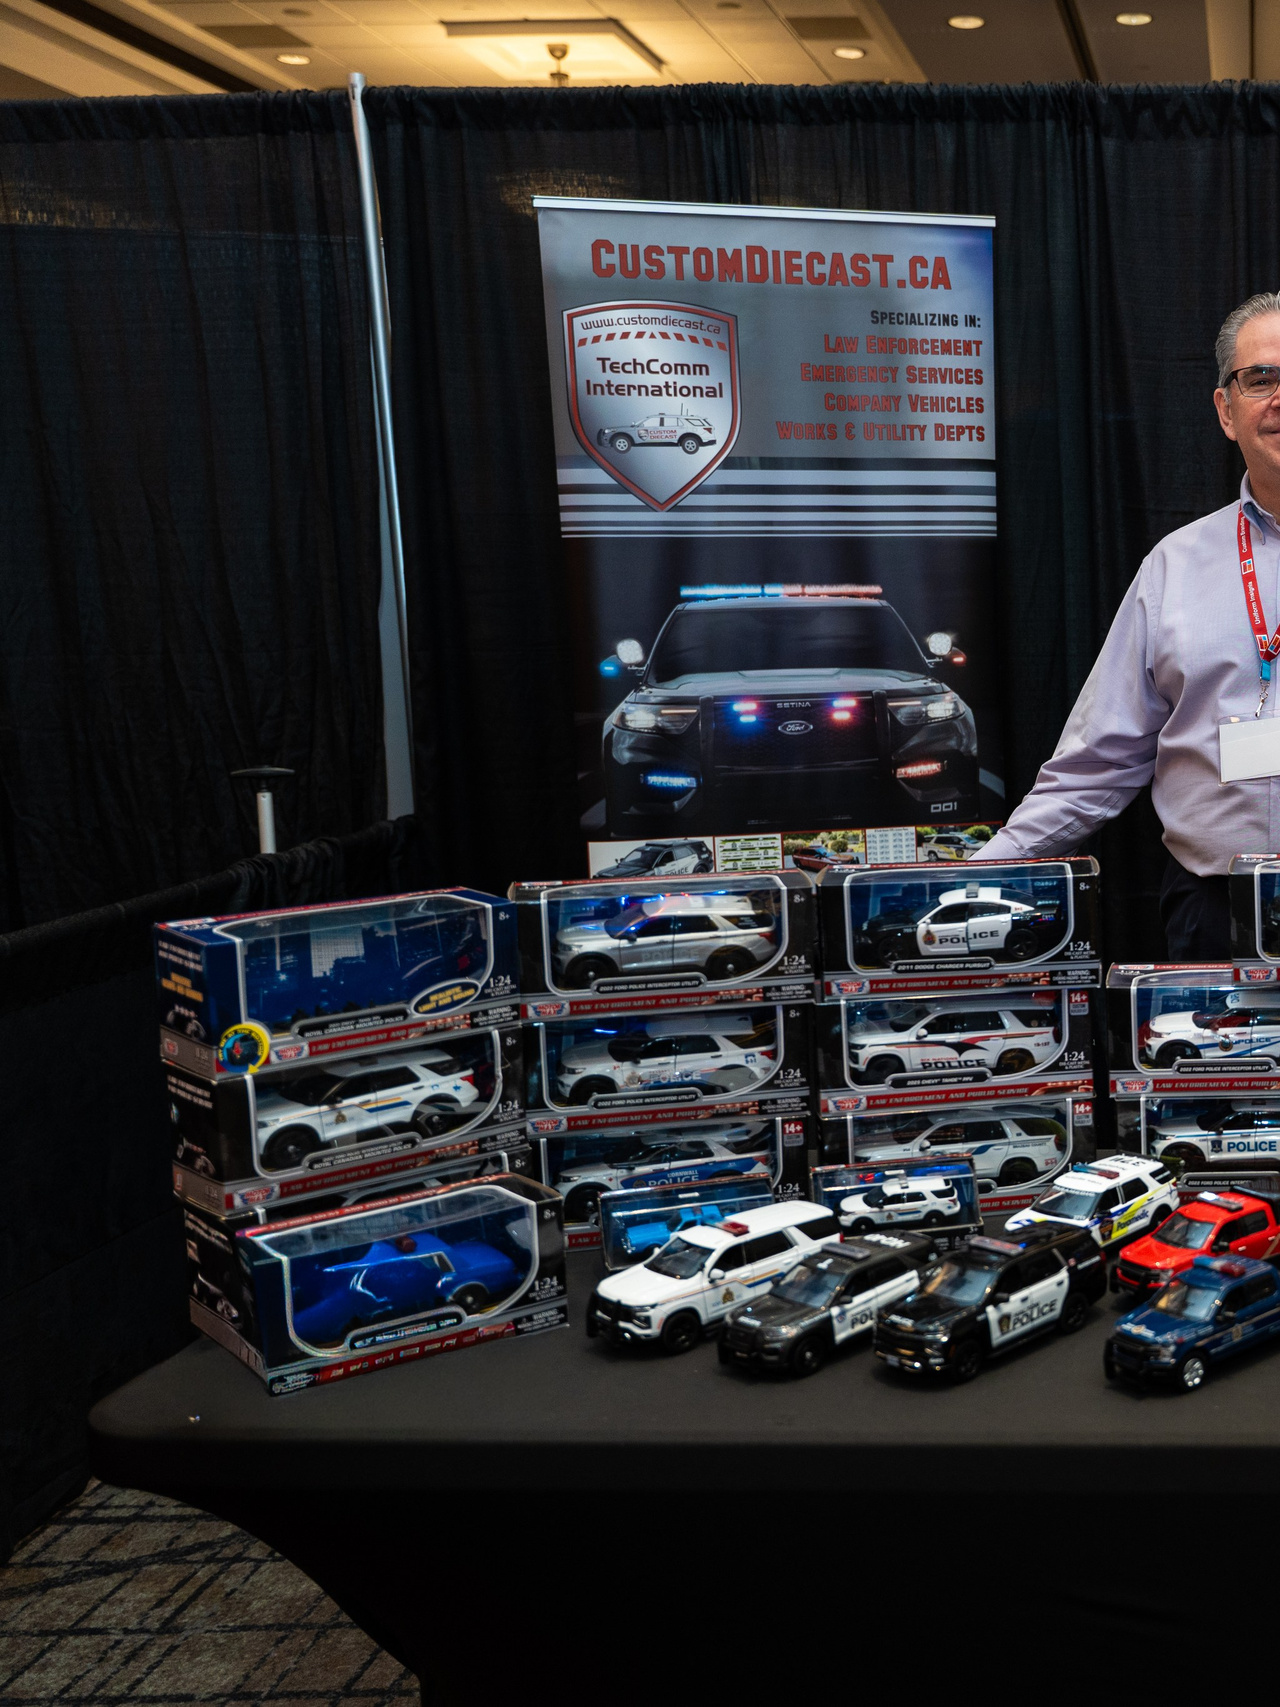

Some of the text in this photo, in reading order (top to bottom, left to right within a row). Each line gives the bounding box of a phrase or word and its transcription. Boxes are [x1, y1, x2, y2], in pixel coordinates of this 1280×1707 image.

[581, 315, 721, 334] www.customdiecast.ca
[871, 310, 981, 328] SPECIALIZING IN:
[824, 334, 983, 356] LAW ENFORCEMENT
[596, 357, 710, 375] TechComm
[800, 363, 984, 385] EMERGENCY SERVICES
[585, 379, 723, 398] International
[824, 393, 984, 413] COMPANY VEHICLES
[776, 421, 837, 440] WORKS
[864, 422, 927, 440] UTILITY
[934, 423, 985, 442] DEPTS
[1246, 581, 1261, 625] Uniform Insignia
[776, 701, 811, 709] SETINA
[1079, 882, 1090, 891] 8+
[794, 893, 806, 903] 8+
[937, 930, 1000, 945] POLICE
[1068, 941, 1091, 951] 1:24
[783, 954, 806, 966] 1:24
[489, 975, 511, 988] 1:24
[1070, 993, 1088, 1002] 14+
[789, 1010, 800, 1018] 8+
[1237, 1037, 1272, 1045] POLICE
[1063, 1051, 1085, 1061] 1:24
[921, 1058, 987, 1070] POLICE
[778, 1068, 801, 1079] 1:24
[498, 1101, 520, 1113] 1:24
[1074, 1103, 1092, 1114] 14+
[784, 1123, 802, 1133] 14+
[1227, 1141, 1277, 1152] POLICE
[778, 1183, 800, 1193] 1:24
[1116, 1209, 1150, 1231] Paramedic
[534, 1276, 557, 1289] 1:24
[1013, 1299, 1058, 1330] POLICE
